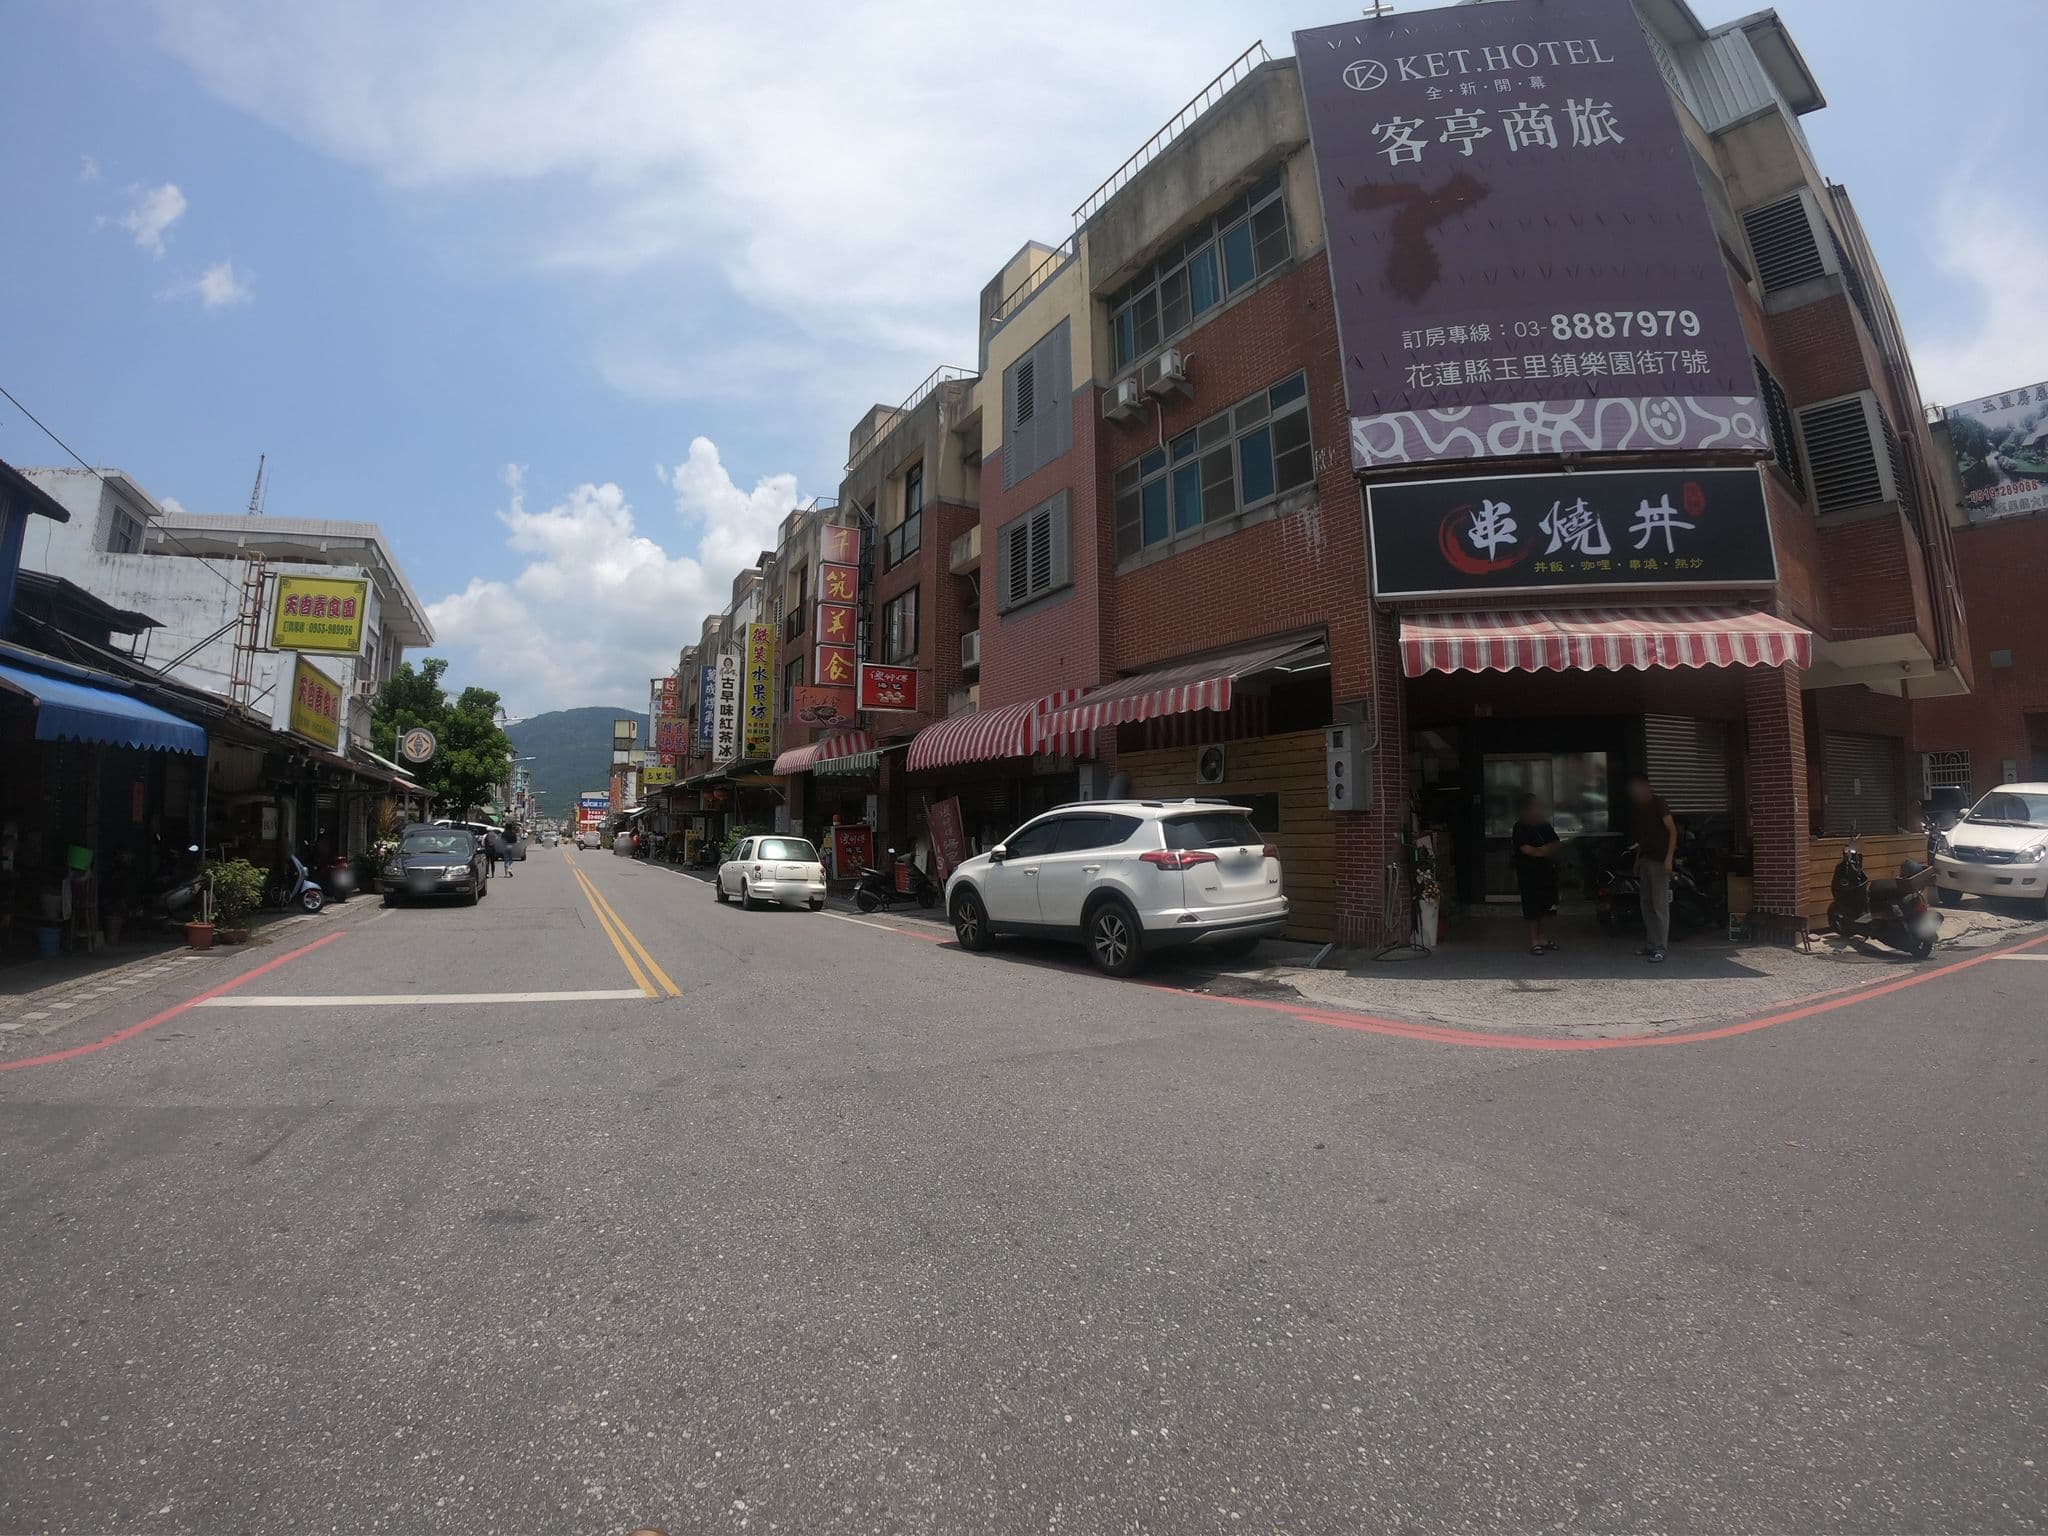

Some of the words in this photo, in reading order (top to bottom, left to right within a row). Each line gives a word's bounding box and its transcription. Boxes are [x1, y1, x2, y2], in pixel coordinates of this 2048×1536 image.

[1395, 39, 1614, 81] KET.HOTEL
[1371, 98, 1626, 165] 客亭商旅
[1405, 349, 1710, 389] 花蓮縣玉里鎮樂園街7號
[1468, 494, 1696, 563] 串燒丼
[751, 628, 770, 720] 微笑水果坊
[718, 676, 735, 758] 古早味紅茶冰
